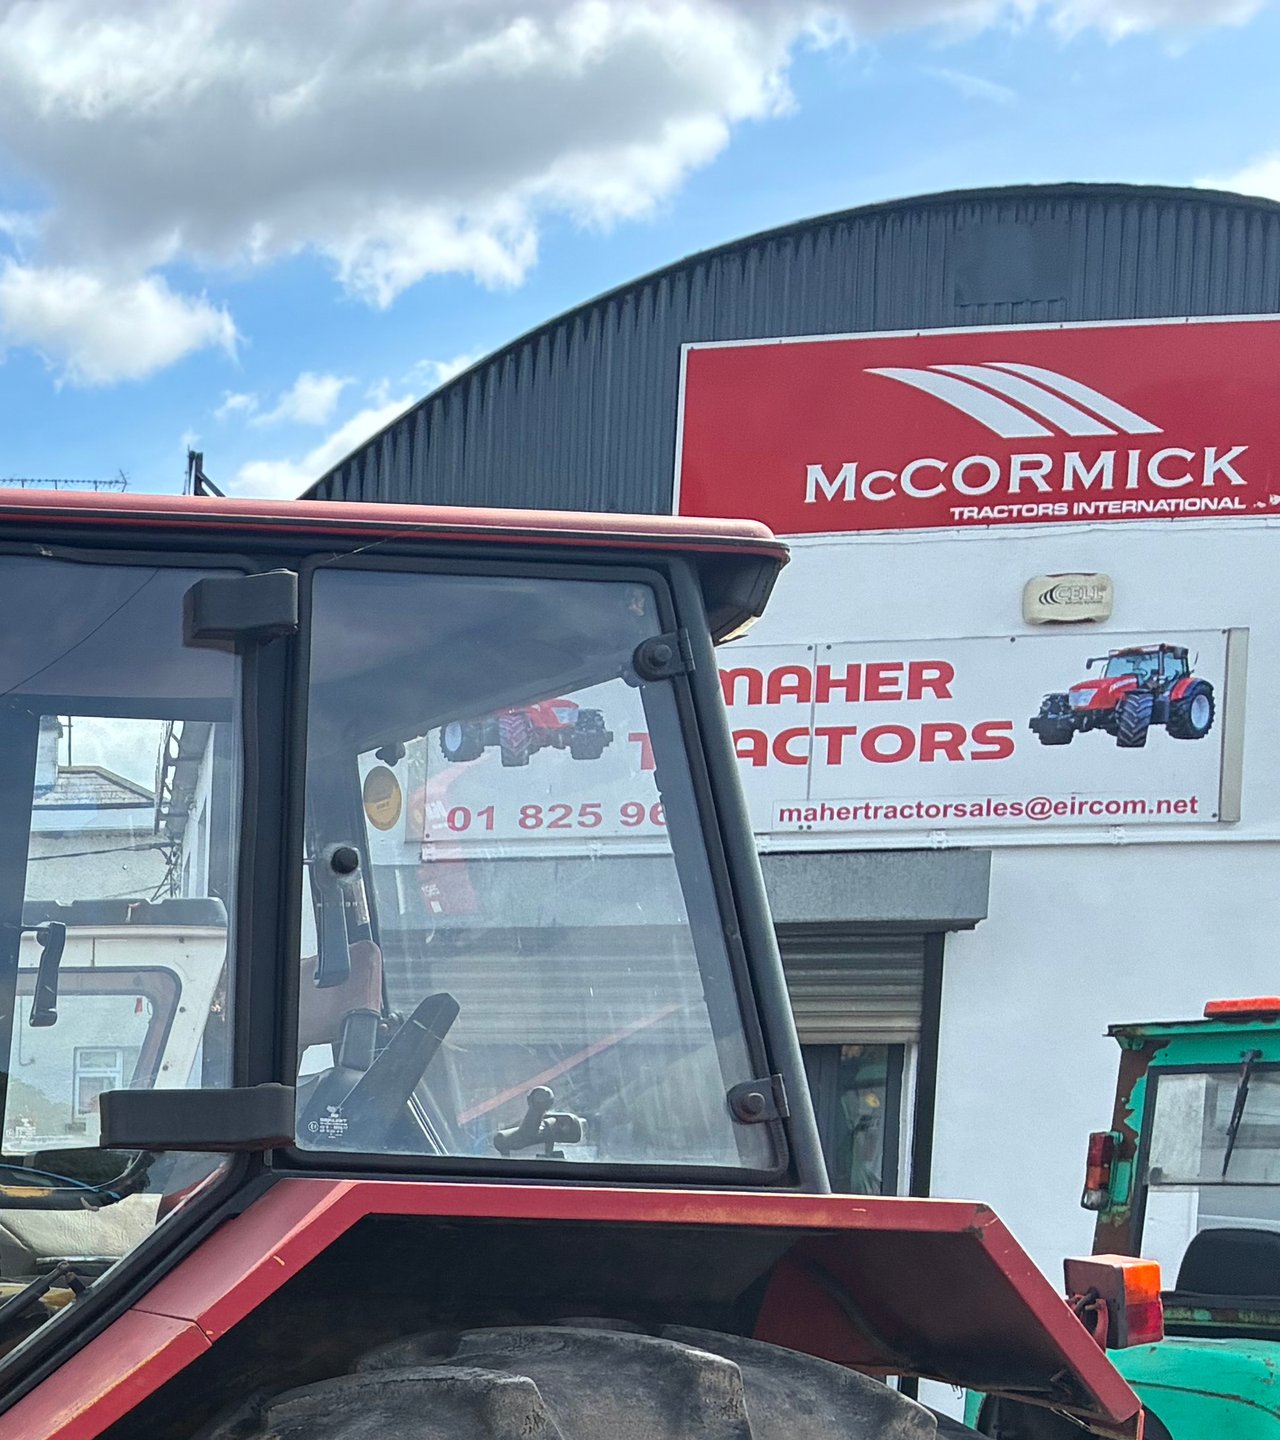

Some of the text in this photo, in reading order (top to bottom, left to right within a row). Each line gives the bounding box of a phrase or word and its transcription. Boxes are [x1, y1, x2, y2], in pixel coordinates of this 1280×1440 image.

[804, 445, 1249, 503] McCORMICK
[950, 496, 1247, 521] TRACTORS INTERNATIONAL
[718, 660, 955, 706] MAHER
[628, 721, 1015, 770] TACTORS
[445, 805, 496, 832] 01
[518, 802, 603, 830] 825
[778, 796, 1199, 823] mahertractorsales@eircom.net
